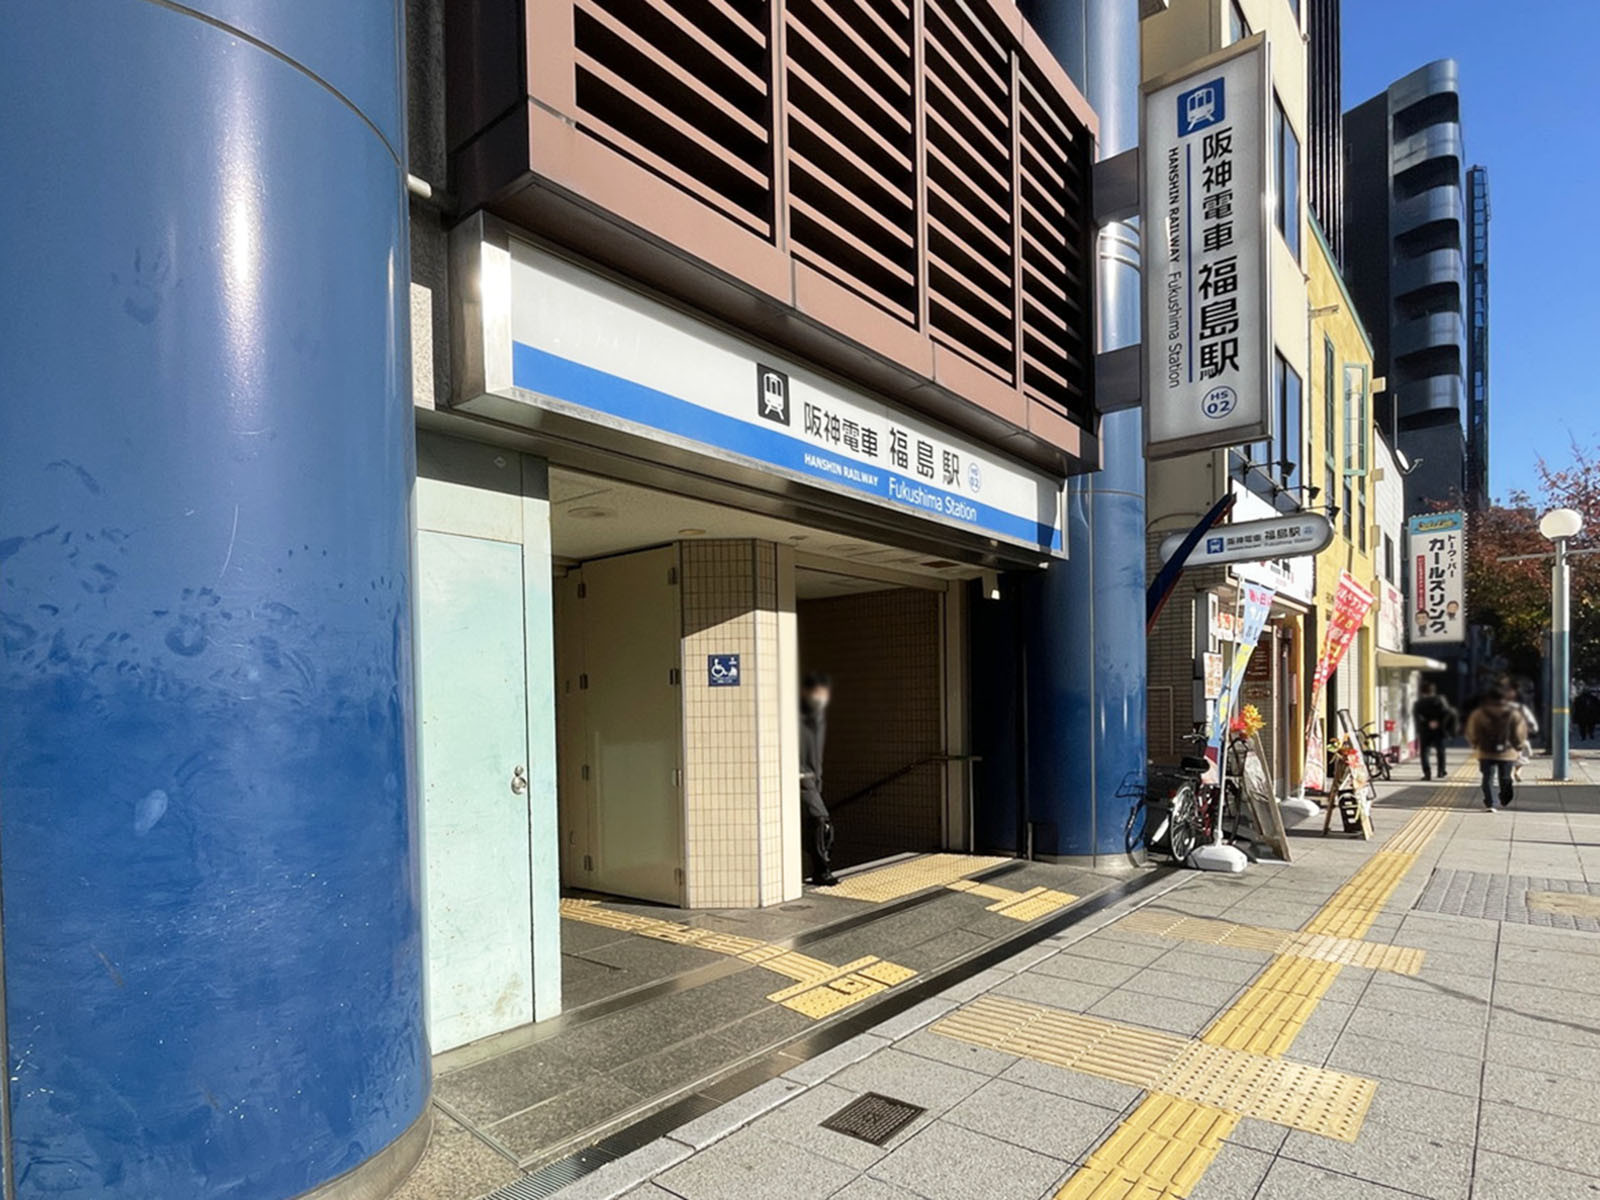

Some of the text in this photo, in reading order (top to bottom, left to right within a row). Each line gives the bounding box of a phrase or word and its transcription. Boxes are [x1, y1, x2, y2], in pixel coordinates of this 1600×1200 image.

[1167, 147, 1183, 388] HANSHIN RAILWAY Fukushima Station
[1198, 127, 1240, 382] 阪神電車 福島駅
[1206, 400, 1230, 414] 02
[1210, 390, 1229, 401] HS
[803, 402, 961, 489] 阪神電車 福島駅
[804, 453, 977, 522] HANSHIN RAILWAY Fukushima Station
